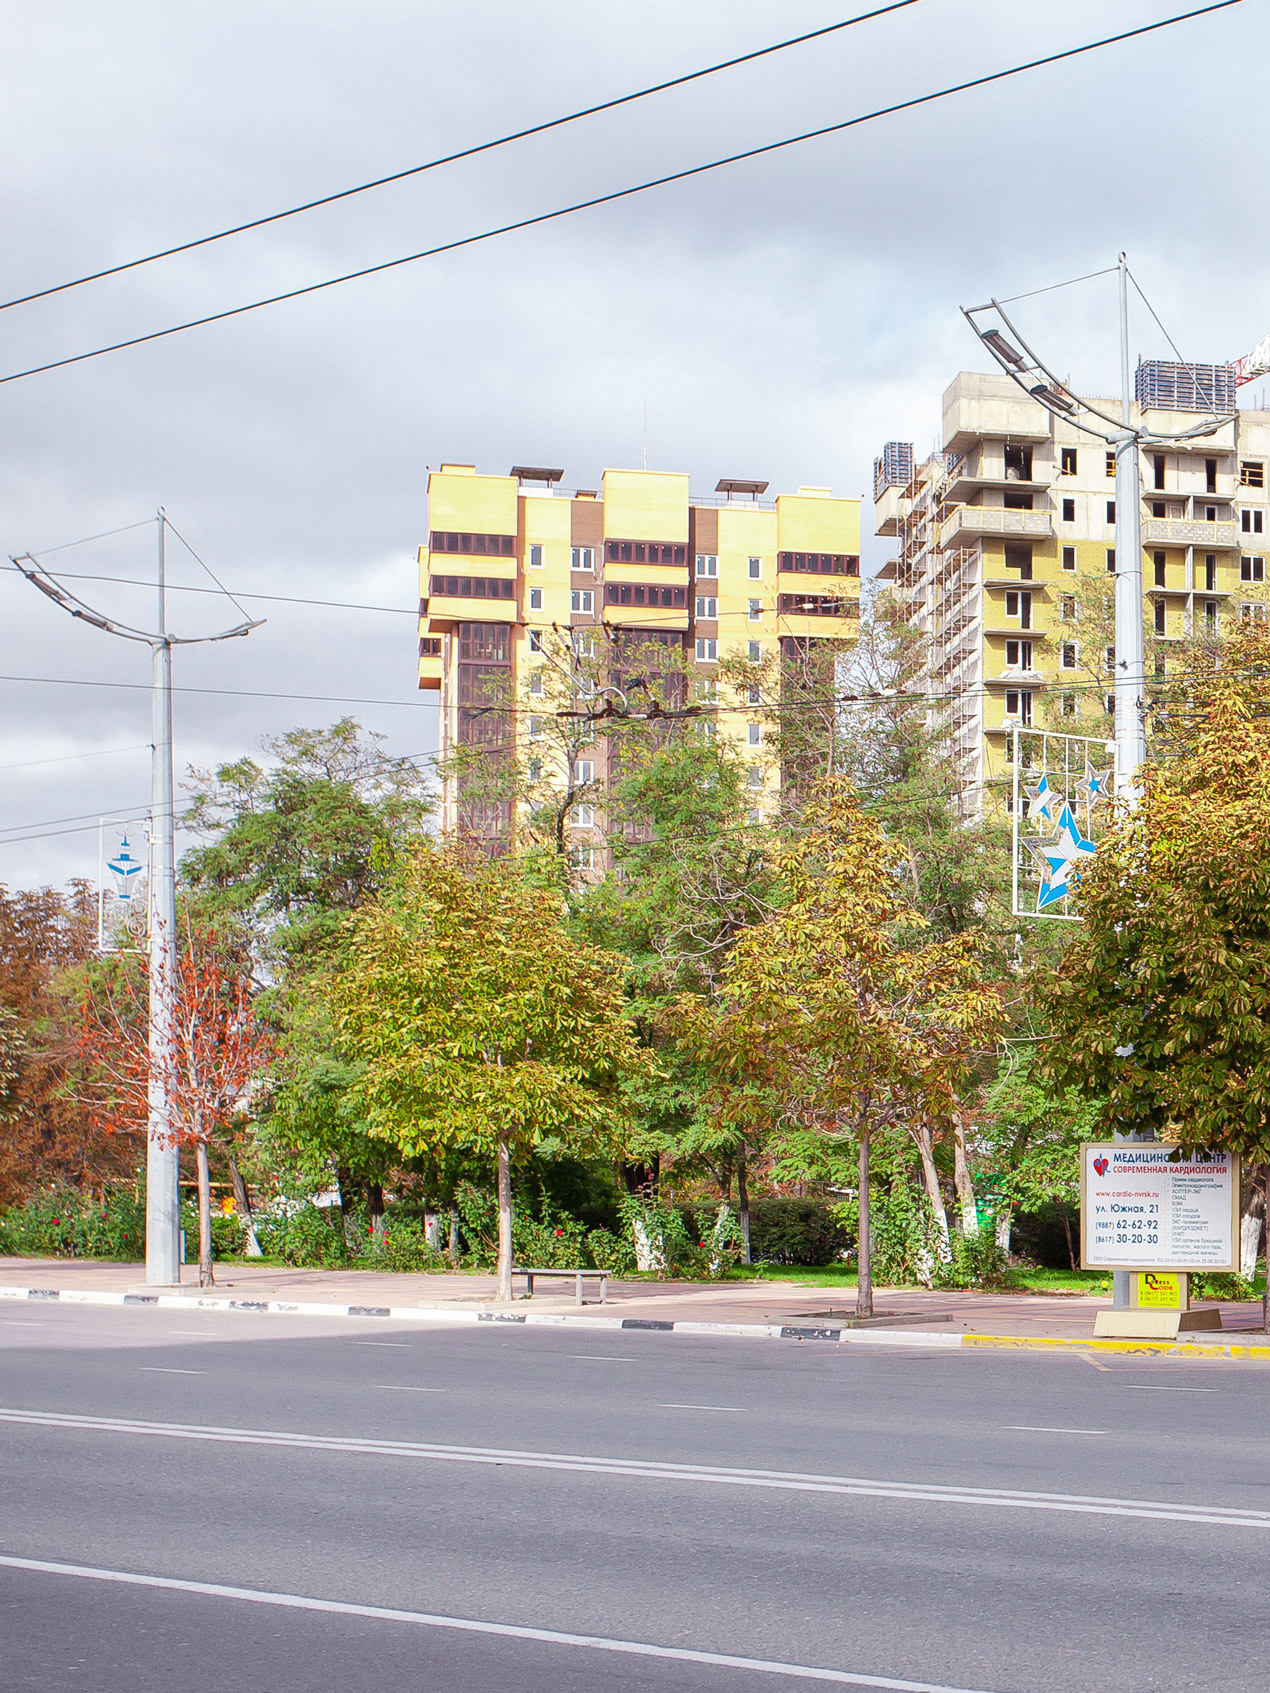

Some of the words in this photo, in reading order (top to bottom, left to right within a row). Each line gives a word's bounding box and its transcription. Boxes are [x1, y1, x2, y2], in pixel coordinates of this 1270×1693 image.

[1113, 1153, 1192, 1164] МЕДИЦИНС
[1195, 1153, 1227, 1164] ЦНТР
[1113, 1166, 1167, 1174] СОВРЕМЕННАЯ
[1169, 1166, 1228, 1176] КАРДИОЛОГИЯ
[1096, 1205, 1108, 1214] ул.
[1110, 1204, 1147, 1214] Южная,
[1149, 1204, 1159, 1213] 21
[1116, 1219, 1159, 1230] 62-62-92
[1116, 1233, 1159, 1244] 30-20-30
